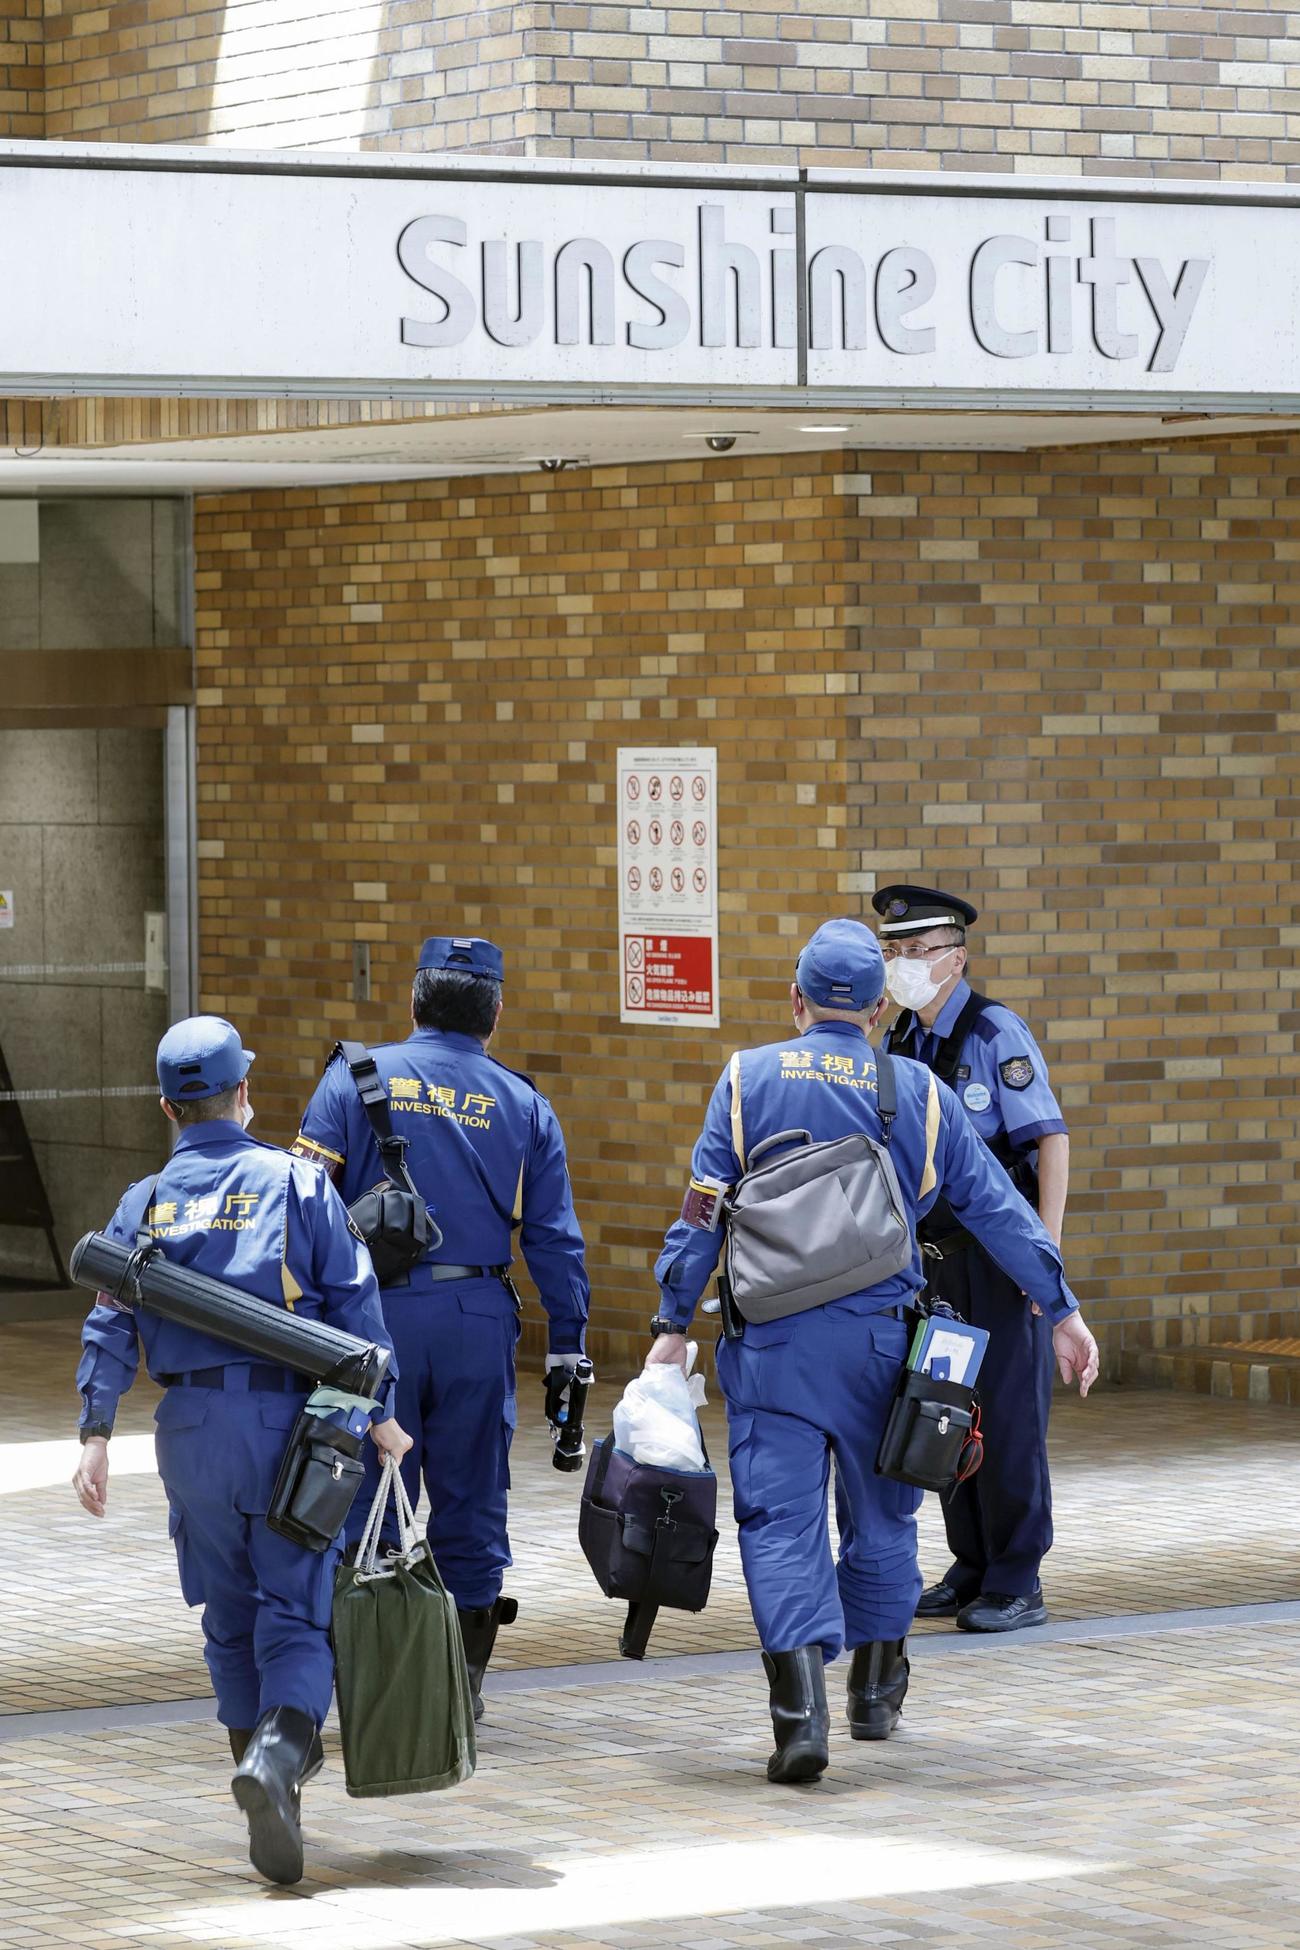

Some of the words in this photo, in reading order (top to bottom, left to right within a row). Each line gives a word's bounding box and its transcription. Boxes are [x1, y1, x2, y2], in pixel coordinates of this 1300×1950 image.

[397, 205, 936, 354] Sunshine
[970, 216, 1210, 372] City
[388, 1077, 496, 1115] 警視庁
[781, 1069, 878, 1093] INVESTIGATIO
[390, 1100, 491, 1130] INVESTIGATION
[149, 1218, 256, 1239] NVESTIGATION
